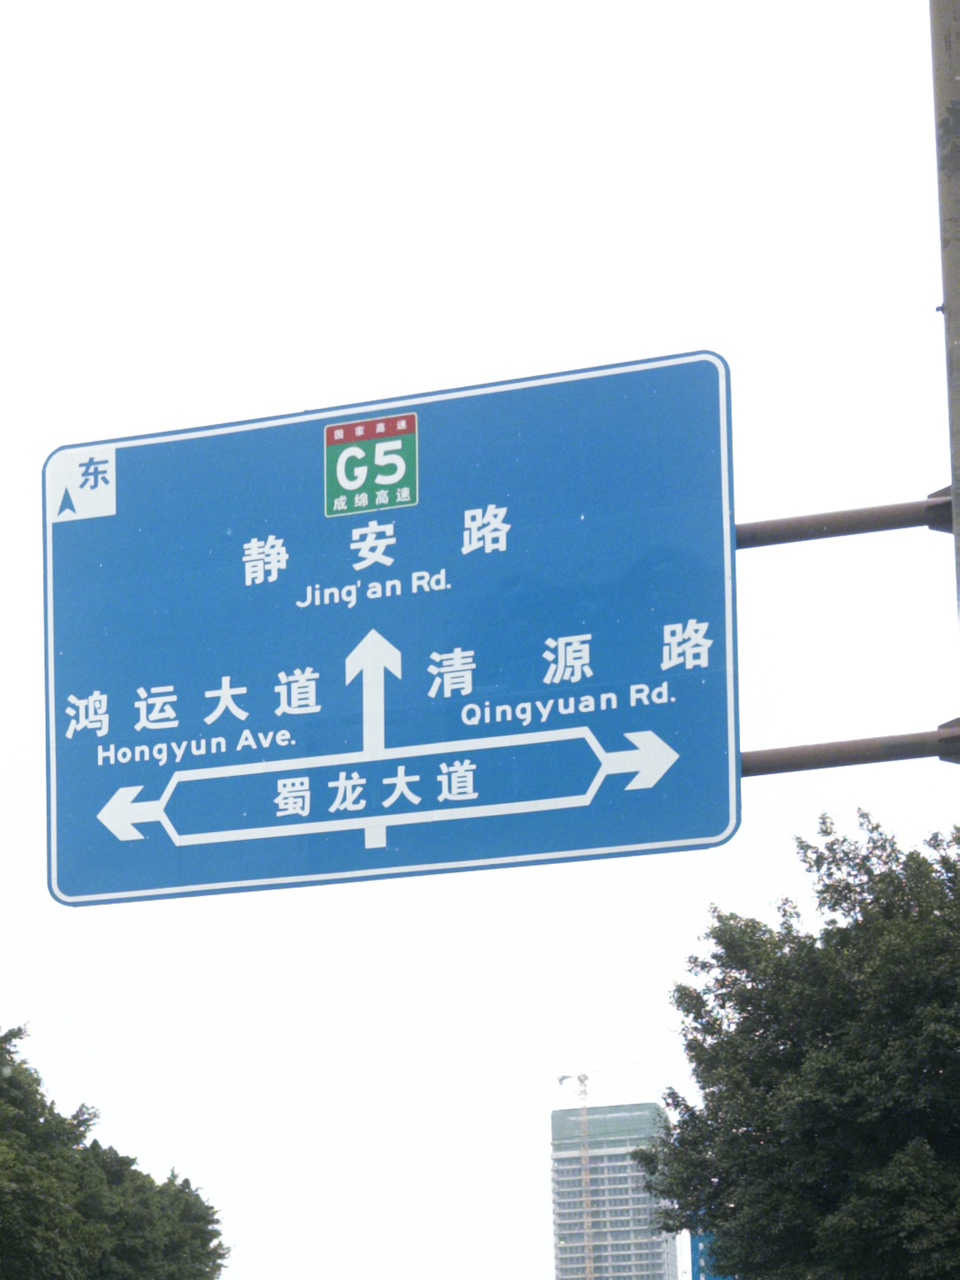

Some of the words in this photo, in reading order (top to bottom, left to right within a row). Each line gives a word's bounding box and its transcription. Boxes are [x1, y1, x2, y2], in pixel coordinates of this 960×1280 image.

[333, 419, 408, 441] 国家高速
[78, 456, 111, 490] 东
[336, 439, 407, 491] G5
[332, 486, 412, 512] 成绵高速
[242, 503, 512, 586] 静安路
[295, 579, 402, 609] Jing'an
[411, 567, 452, 594] Rd.
[427, 618, 714, 698] 清源路
[65, 667, 322, 740] 鸿运大道
[461, 692, 618, 726] Qingyuan
[629, 681, 676, 707] Rd.
[97, 737, 227, 766] Hongyun
[235, 728, 297, 751] Ave.
[273, 760, 480, 818] 蜀龙大道
